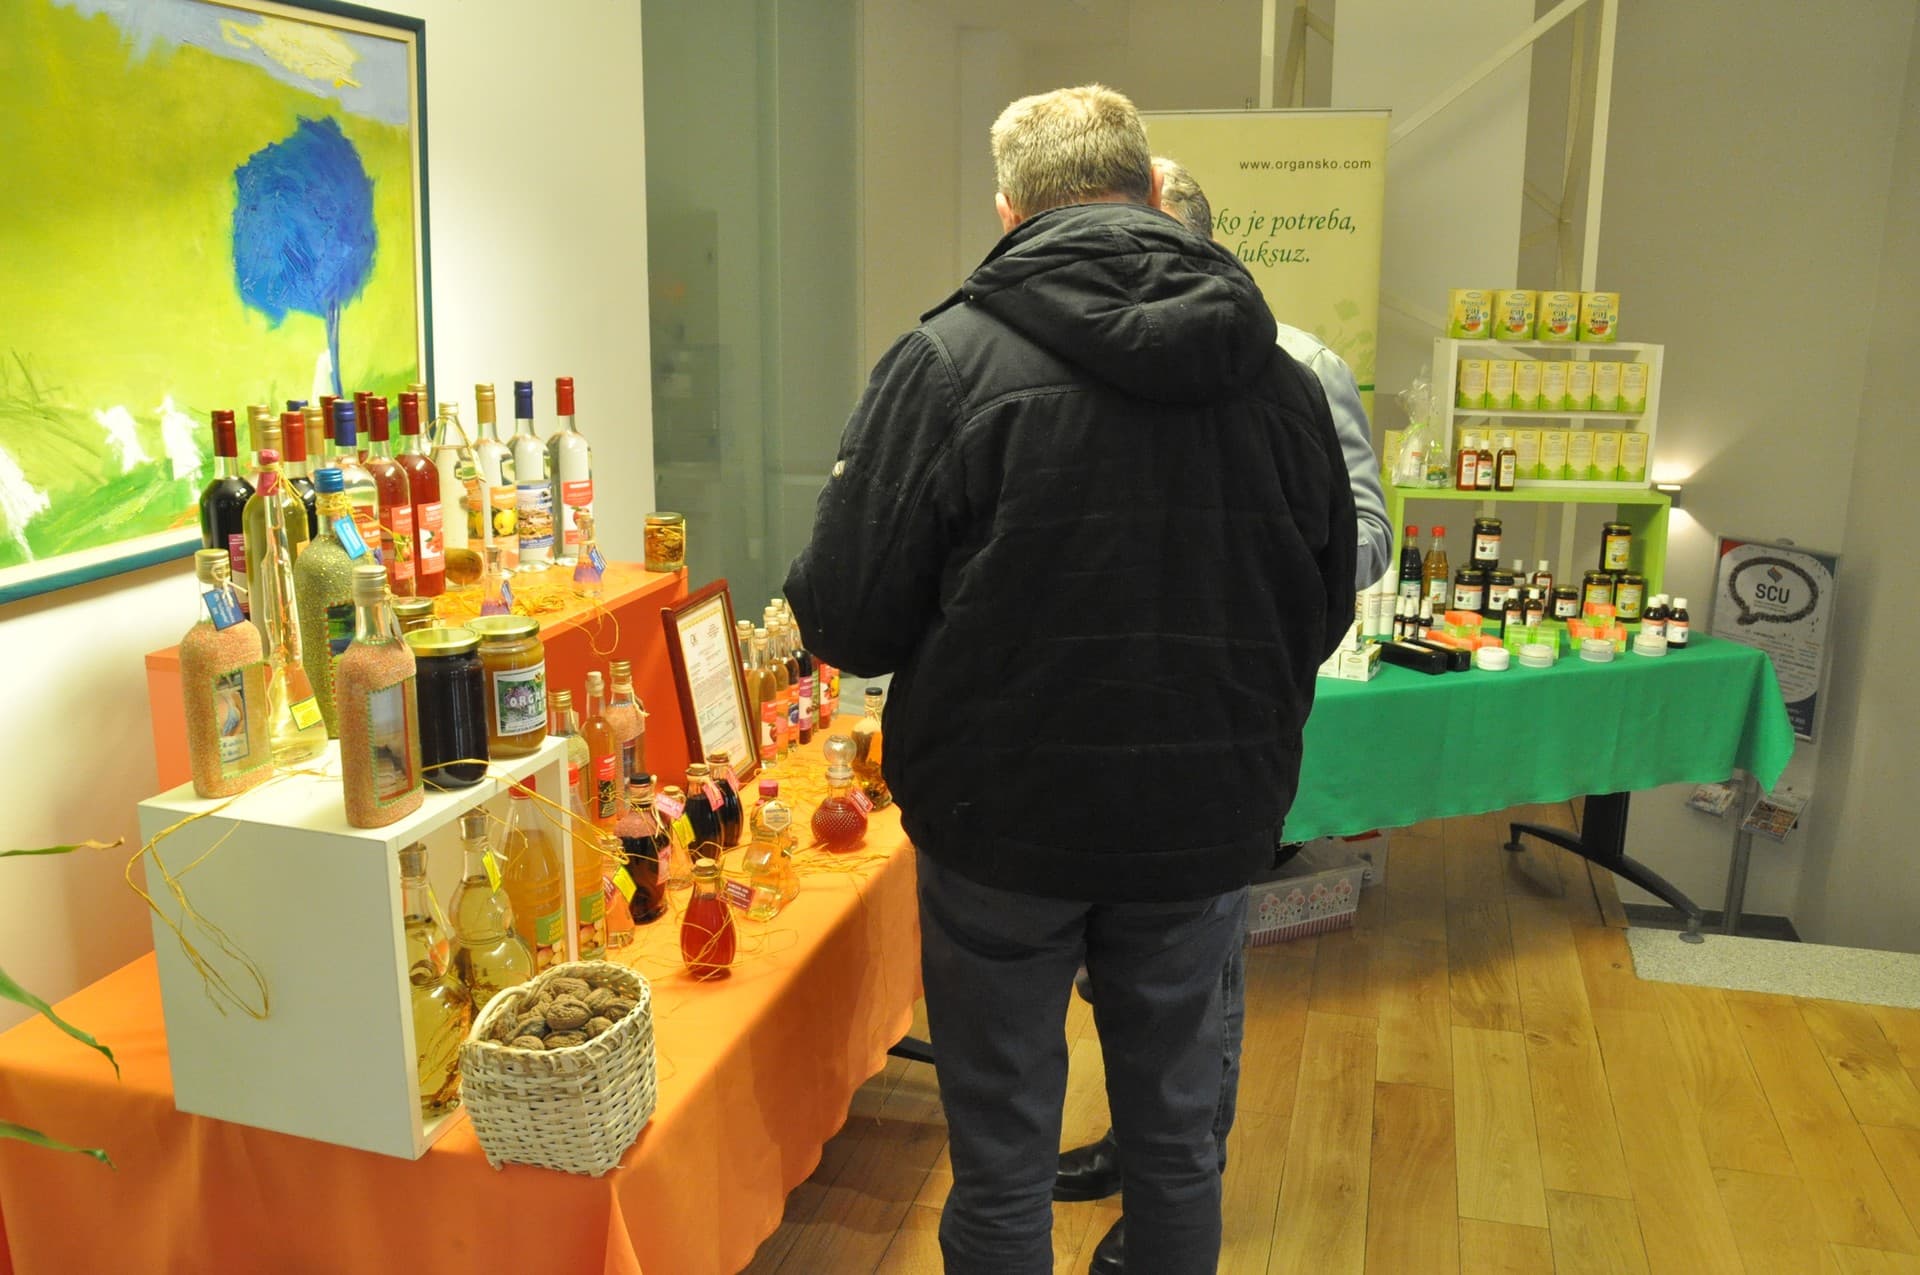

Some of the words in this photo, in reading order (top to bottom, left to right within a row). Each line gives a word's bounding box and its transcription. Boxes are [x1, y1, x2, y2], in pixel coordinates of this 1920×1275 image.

[1239, 158, 1372, 172] www.organsko.com
[1242, 210, 1265, 237] je
[1270, 208, 1356, 237] potreba,
[1236, 241, 1310, 267] luksuz.
[1755, 583, 1790, 604] SCU
